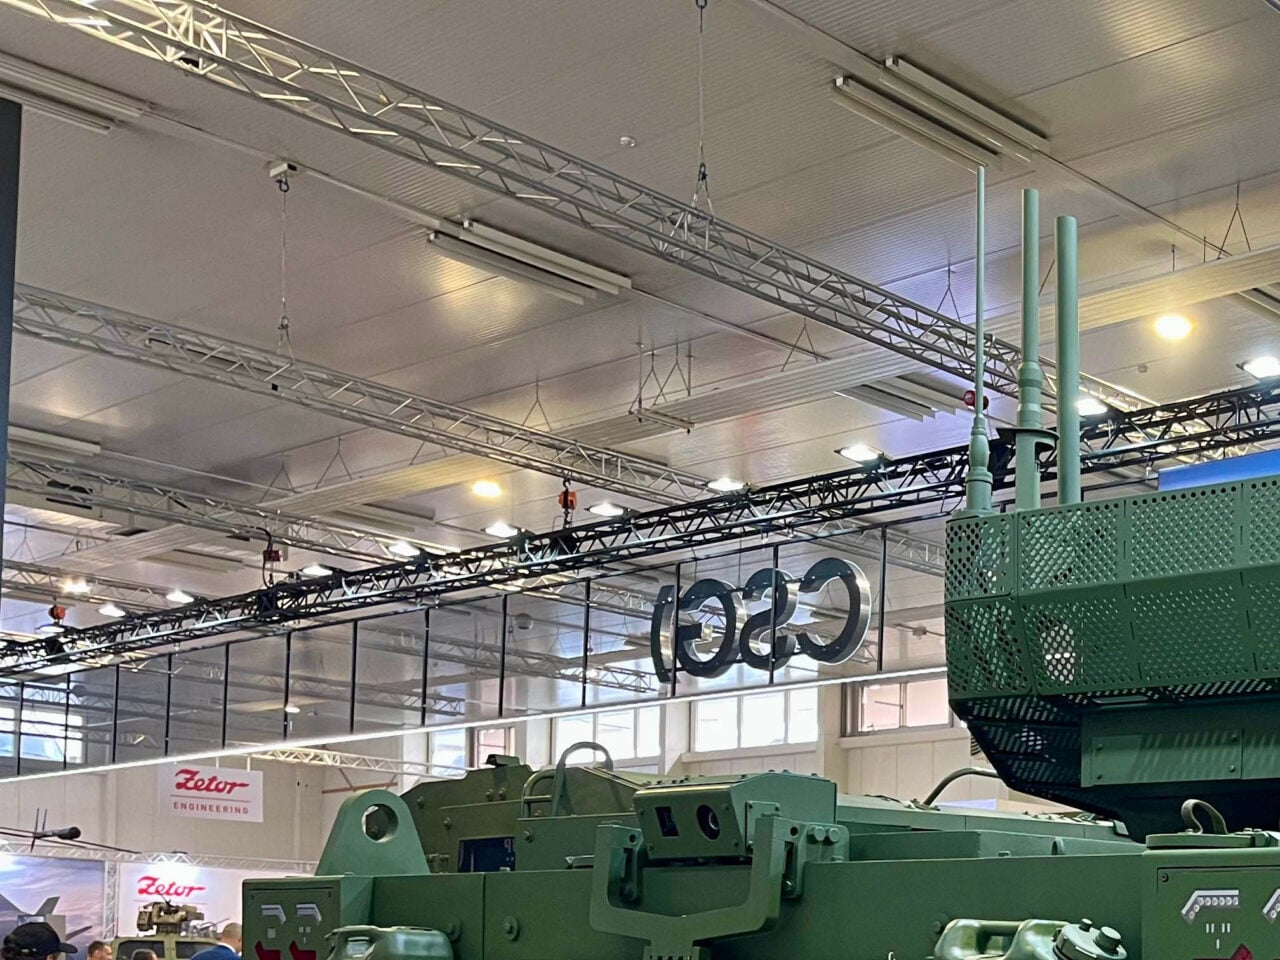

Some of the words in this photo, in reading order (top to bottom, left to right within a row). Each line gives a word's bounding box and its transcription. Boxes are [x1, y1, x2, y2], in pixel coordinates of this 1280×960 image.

[175, 768, 250, 794] Zetor
[173, 801, 249, 815] ENGINEERING
[137, 876, 206, 897] Zetor
